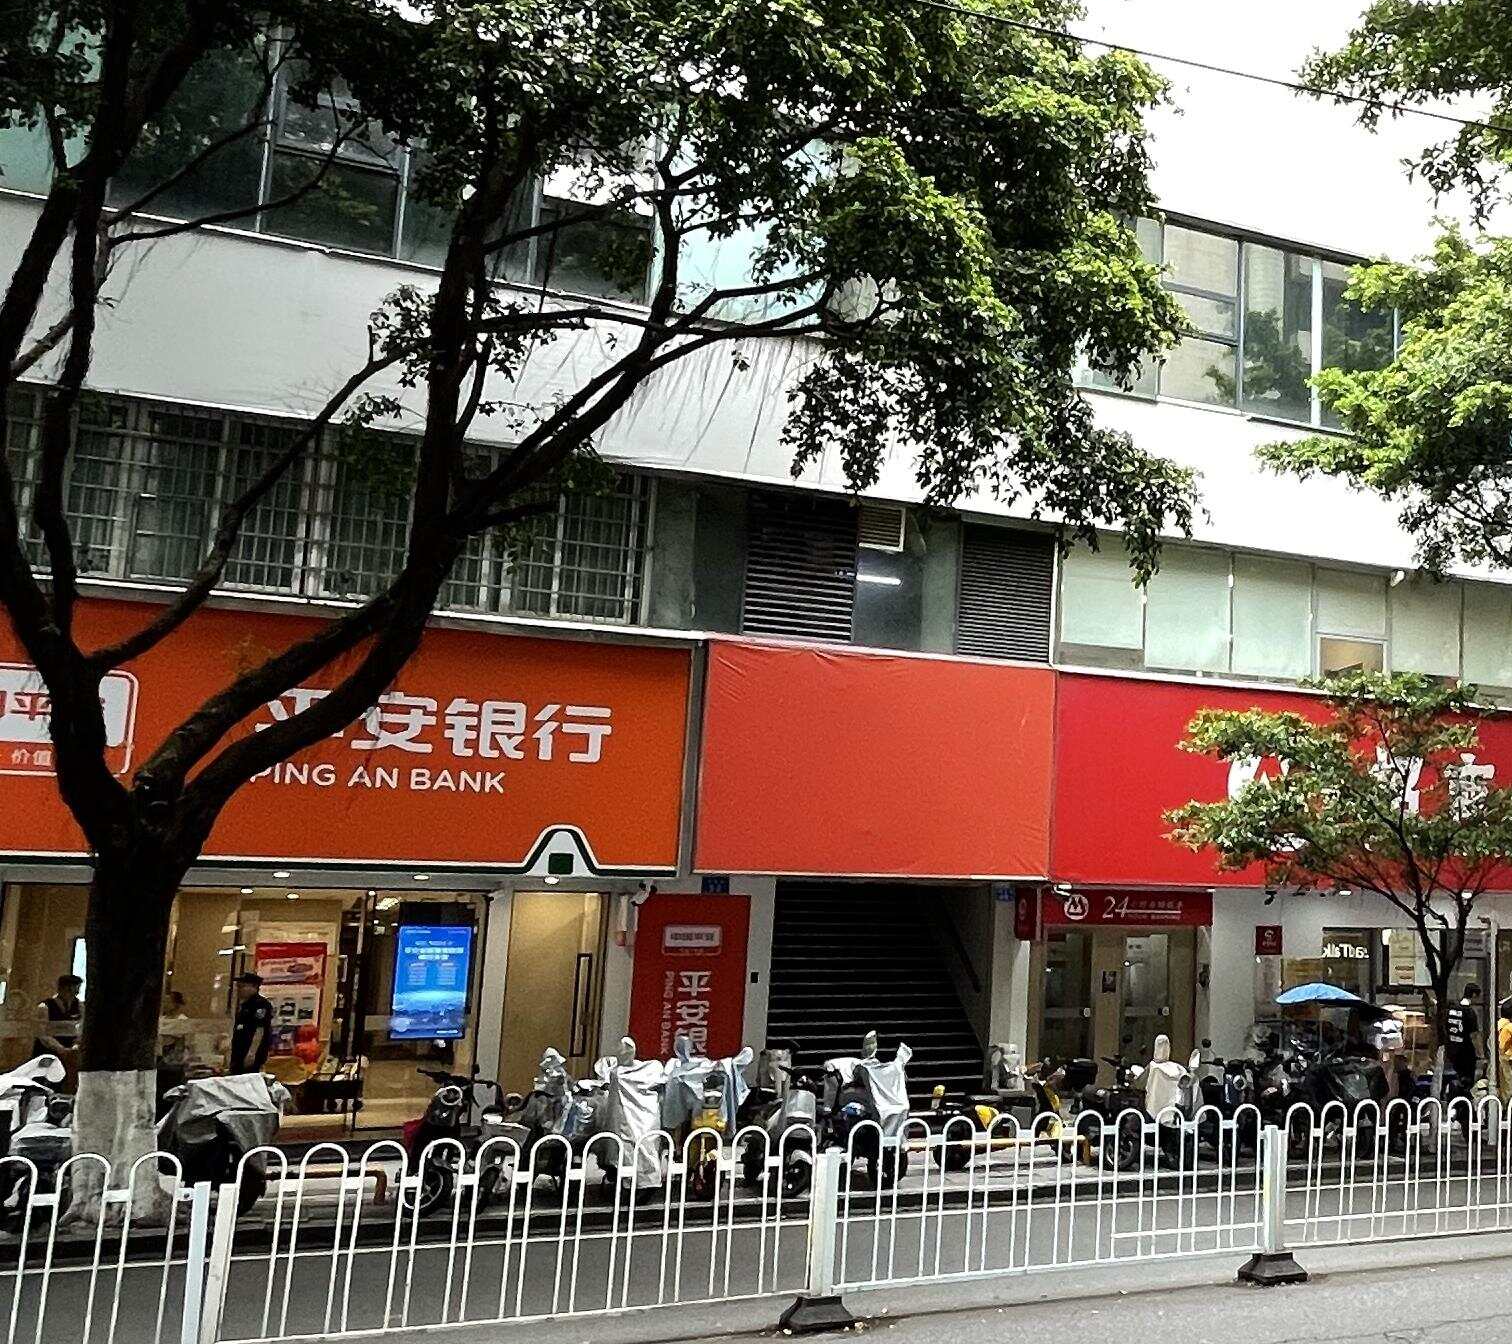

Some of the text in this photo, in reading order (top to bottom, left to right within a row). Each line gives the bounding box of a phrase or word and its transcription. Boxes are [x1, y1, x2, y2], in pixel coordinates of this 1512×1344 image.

[347, 765, 399, 790] AN
[410, 769, 506, 794] BANK
[1101, 895, 1130, 919] 24
